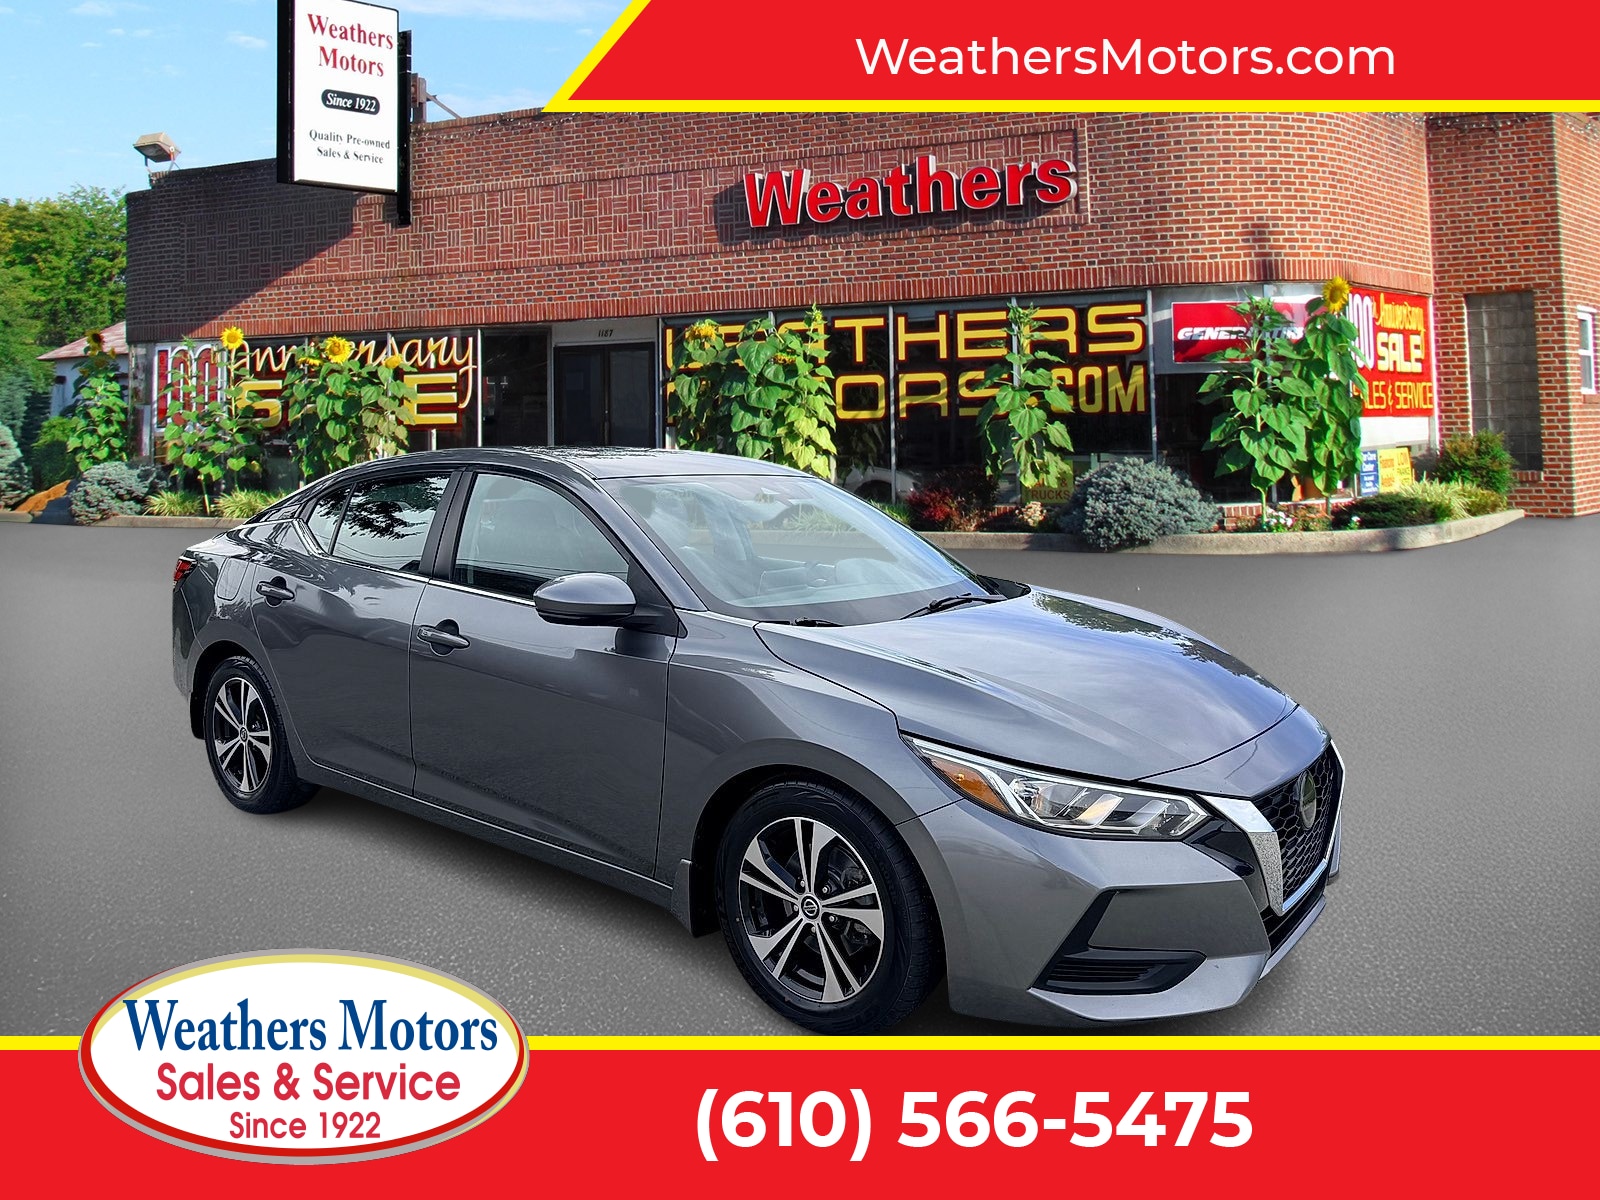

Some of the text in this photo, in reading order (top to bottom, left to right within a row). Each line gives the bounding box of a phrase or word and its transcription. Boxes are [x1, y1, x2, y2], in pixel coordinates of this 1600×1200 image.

[307, 13, 394, 50] Weathers
[318, 45, 384, 77] Motors
[326, 92, 377, 112] Since 1922
[309, 129, 391, 149] Quality Pre-owned
[316, 146, 384, 164] Sales & Service
[743, 154, 1078, 228] Weathers
[598, 328, 614, 338] 1187
[1376, 331, 1423, 373] SALE
[1352, 380, 1387, 410] LES
[1394, 381, 1434, 410] SERVICE
[1026, 489, 1071, 500] RUCKS
